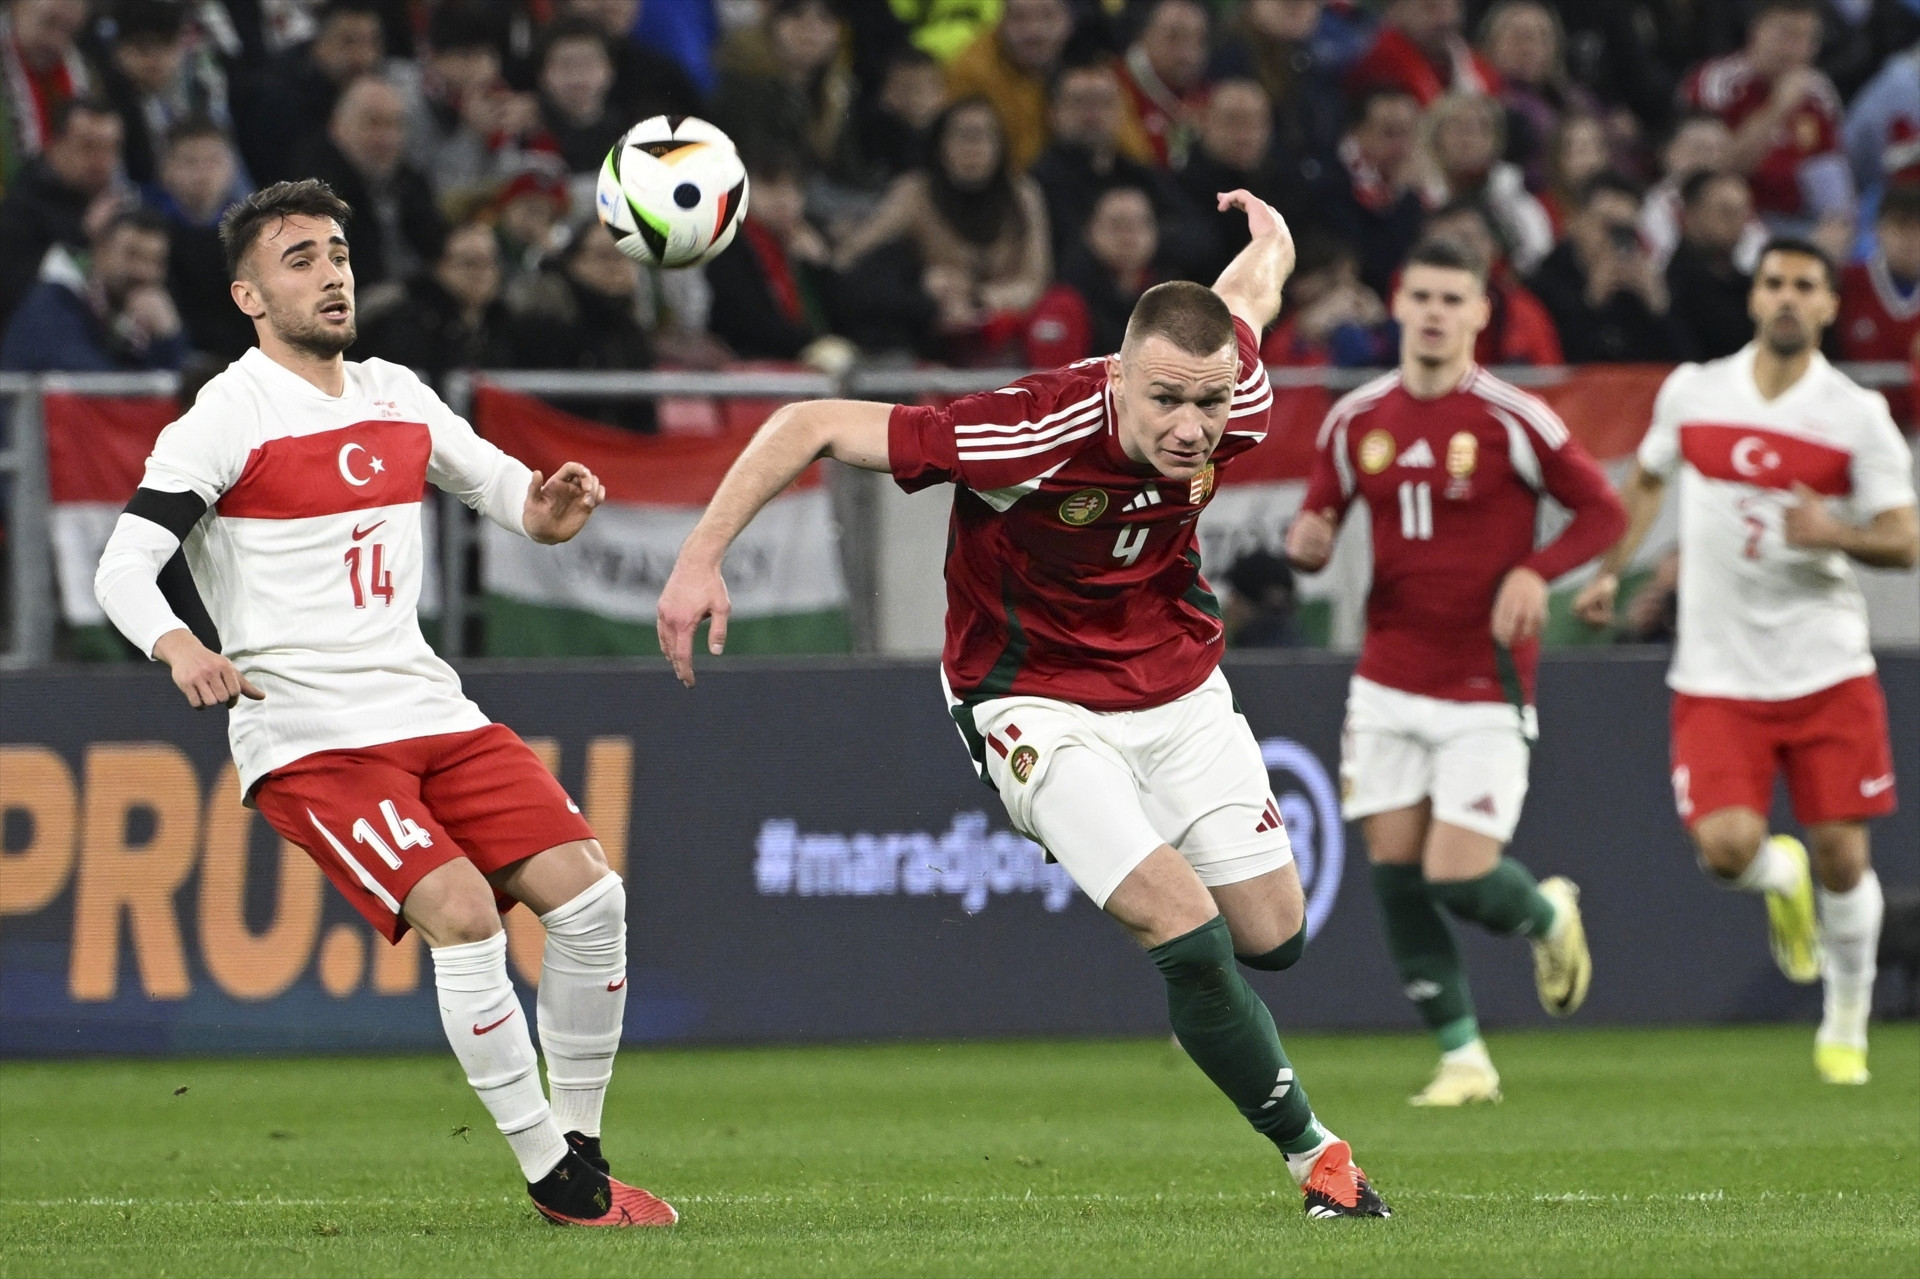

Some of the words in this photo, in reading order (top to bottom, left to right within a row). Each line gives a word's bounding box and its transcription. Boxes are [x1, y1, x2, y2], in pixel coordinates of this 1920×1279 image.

[1398, 480, 1434, 541] 11
[344, 543, 395, 610] 14
[1112, 522, 1151, 567] 4
[352, 799, 434, 871] 14
[0, 738, 634, 1002] PRO.
